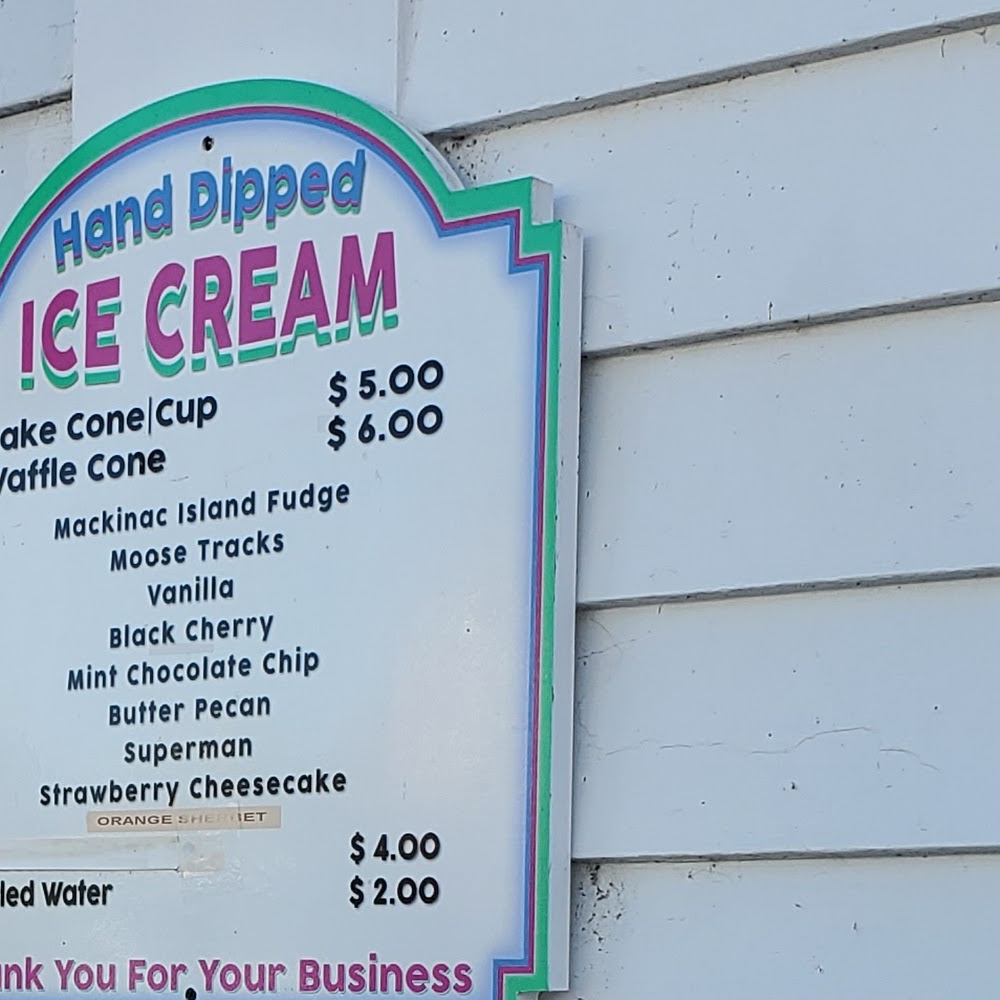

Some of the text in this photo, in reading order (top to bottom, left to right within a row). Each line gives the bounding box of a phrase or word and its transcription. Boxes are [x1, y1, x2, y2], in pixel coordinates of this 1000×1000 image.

[52, 149, 366, 273] Hand Dipped
[20, 231, 400, 391] ICE CREAM
[87, 448, 167, 482] Cone
[54, 482, 350, 540] Mackinac Island Fudge
[110, 530, 284, 572] Moose Tracks
[147, 575, 234, 607] Vanilla
[109, 615, 274, 649] Black Cherry
[67, 646, 319, 691] Mint Chocolate Chip
[109, 696, 271, 726] Butter Pecan
[124, 737, 252, 768] Superman
[40, 768, 347, 807] Strawberry Cheesecake
[97, 815, 173, 826] ORANGE
[41, 879, 114, 907] Water
[55, 960, 115, 990] You
[129, 959, 187, 991] For
[199, 959, 285, 992] Your
[299, 953, 472, 993] Business
